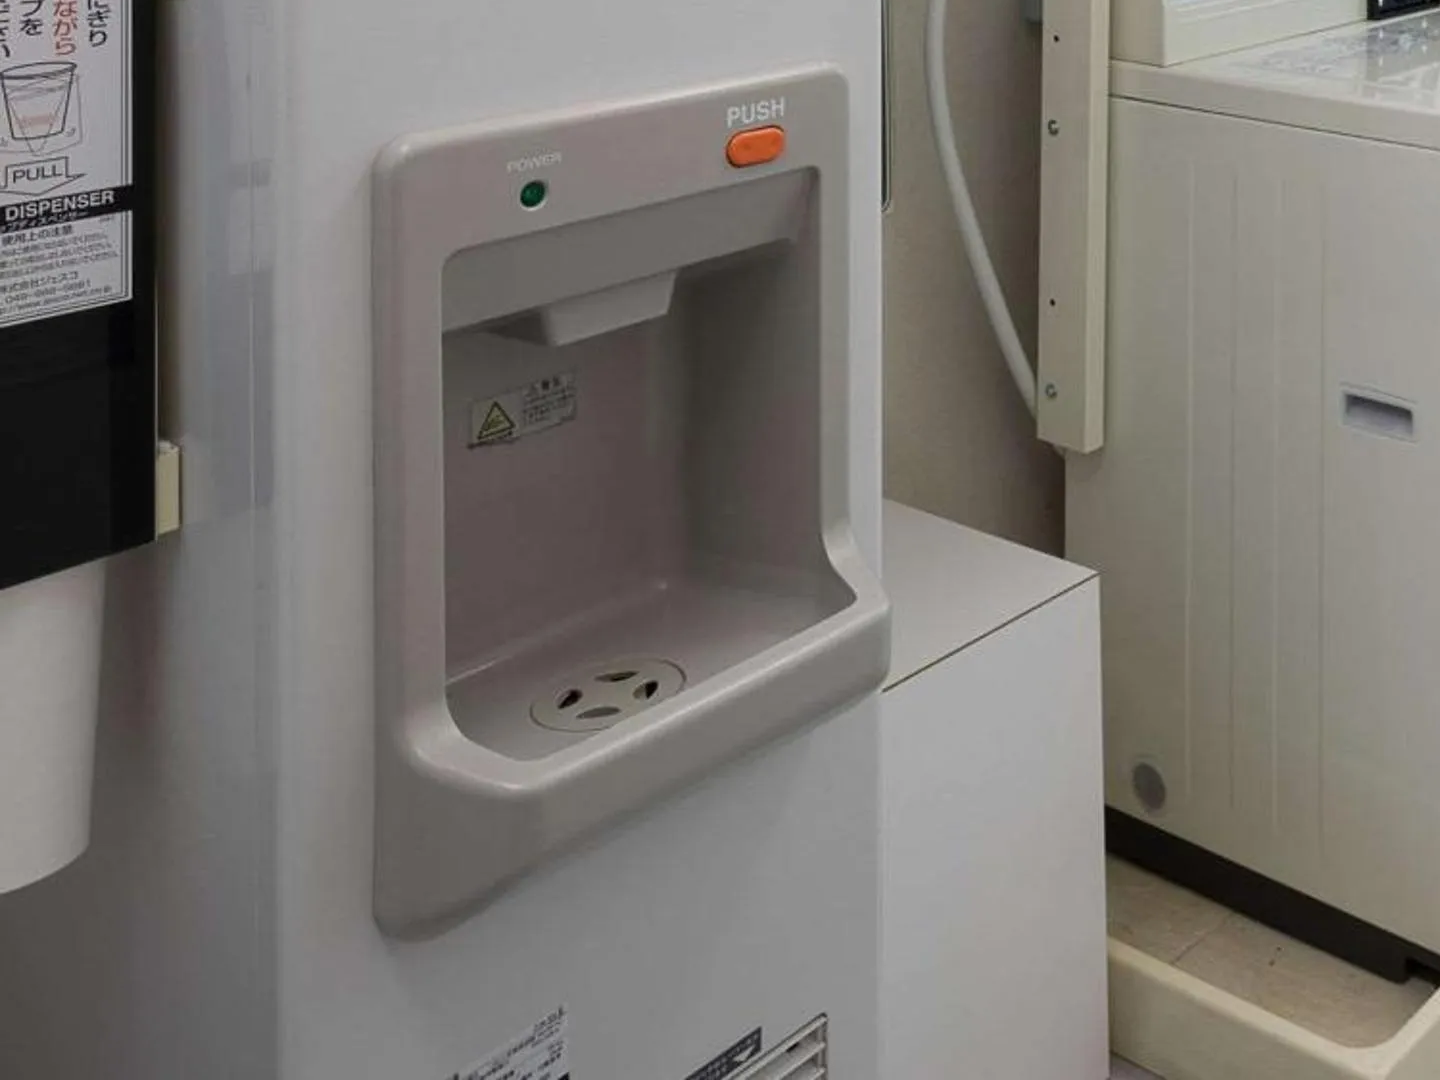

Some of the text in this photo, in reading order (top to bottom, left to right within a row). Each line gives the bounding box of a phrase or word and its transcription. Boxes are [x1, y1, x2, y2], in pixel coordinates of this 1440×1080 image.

[727, 97, 785, 127] PUSH
[13, 165, 62, 184] PULL
[506, 151, 562, 173] POWER
[5, 191, 114, 222] DISPENSER
